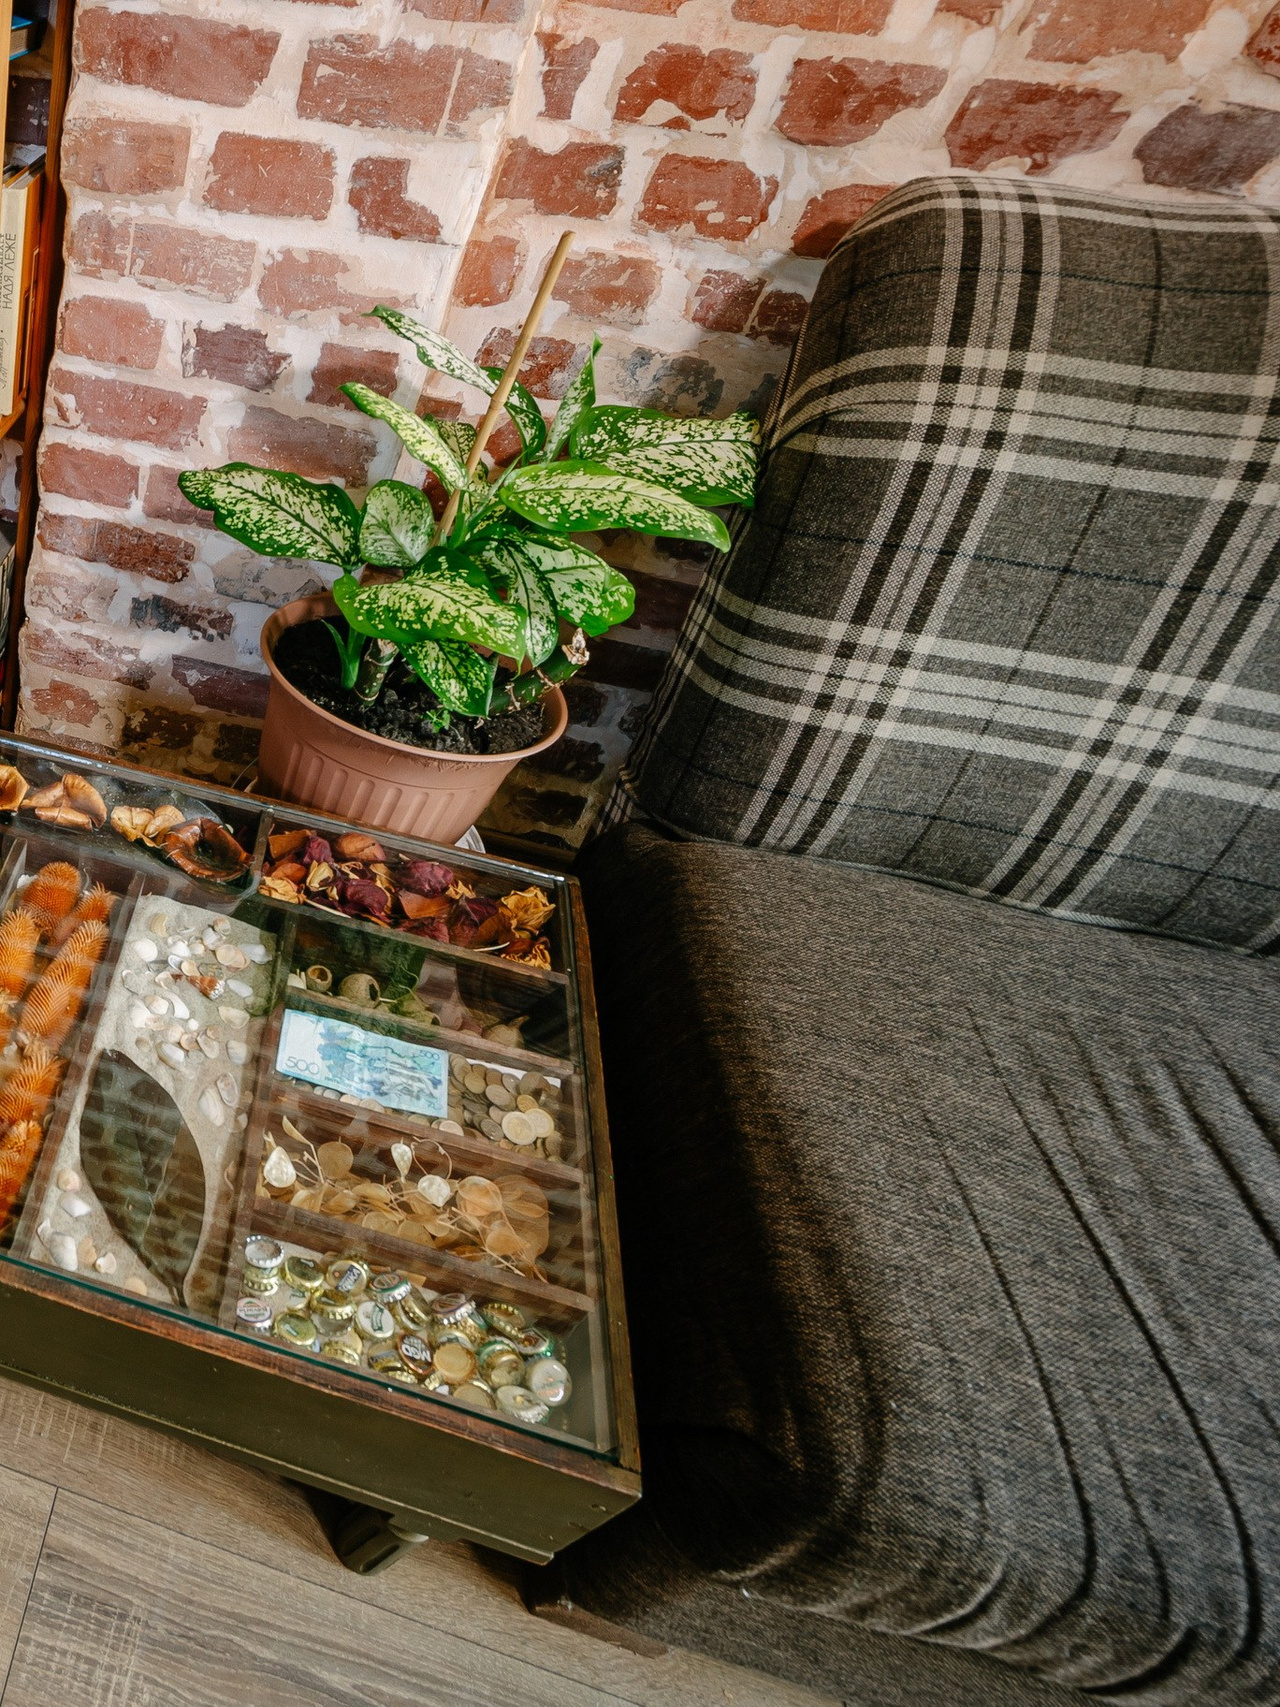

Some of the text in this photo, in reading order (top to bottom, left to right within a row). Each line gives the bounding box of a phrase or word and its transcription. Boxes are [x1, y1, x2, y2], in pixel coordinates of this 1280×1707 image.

[1, 233, 16, 309] НАДЯ ЛЕЖЕ
[285, 1056, 320, 1075] 500
